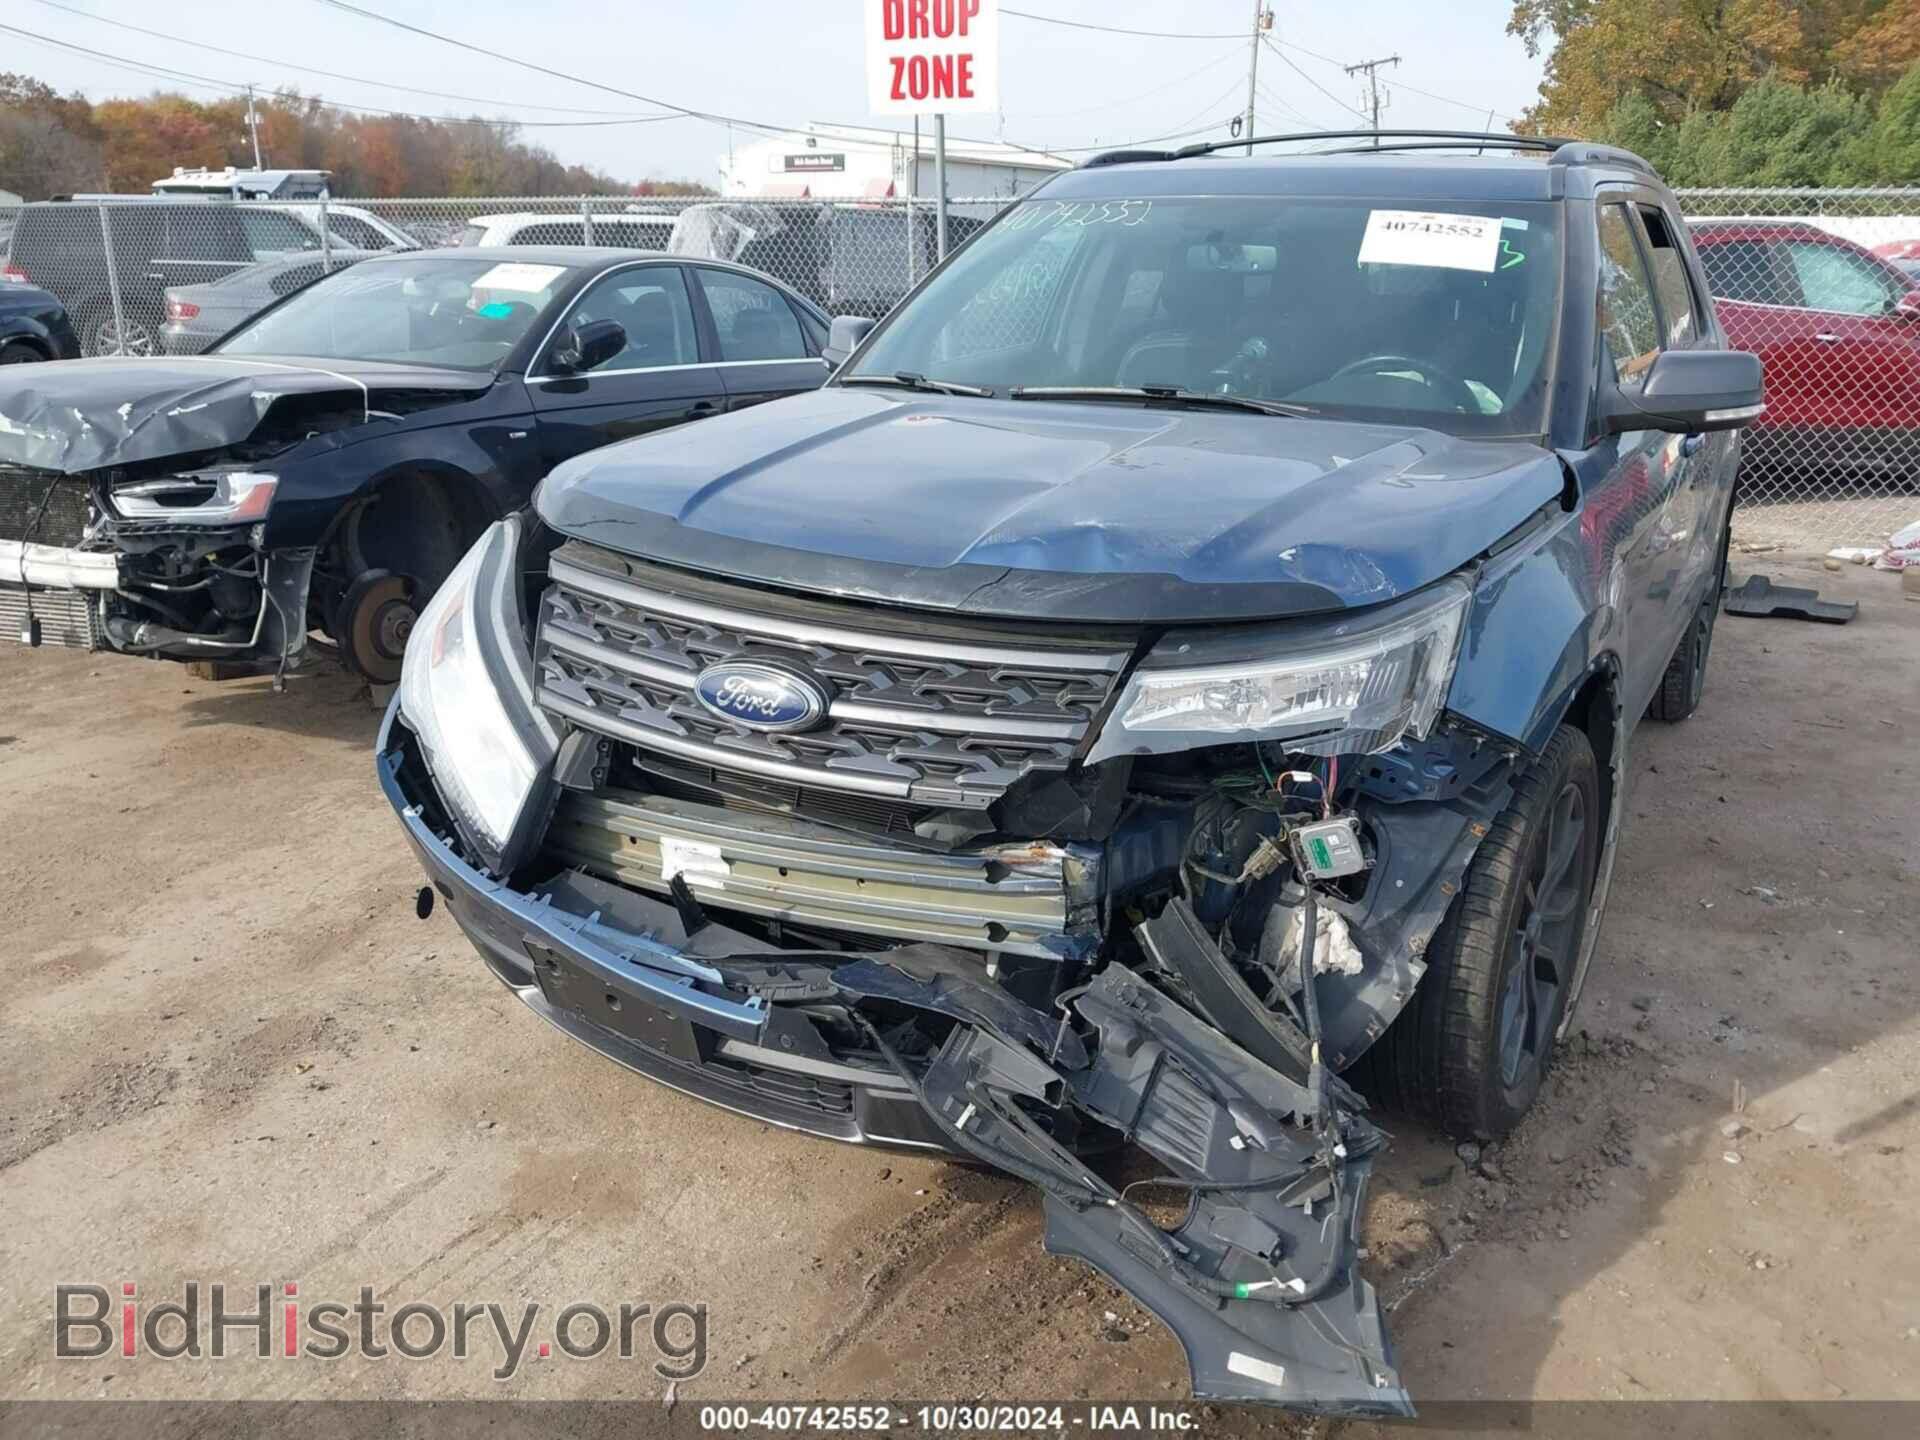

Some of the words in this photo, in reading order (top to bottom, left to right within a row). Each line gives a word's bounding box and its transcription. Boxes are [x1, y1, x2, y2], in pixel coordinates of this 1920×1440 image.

[883, 0, 979, 40] DROP
[889, 54, 974, 100] ZONE
[1380, 220, 1484, 238] 40742552
[716, 675, 781, 716] Ford
